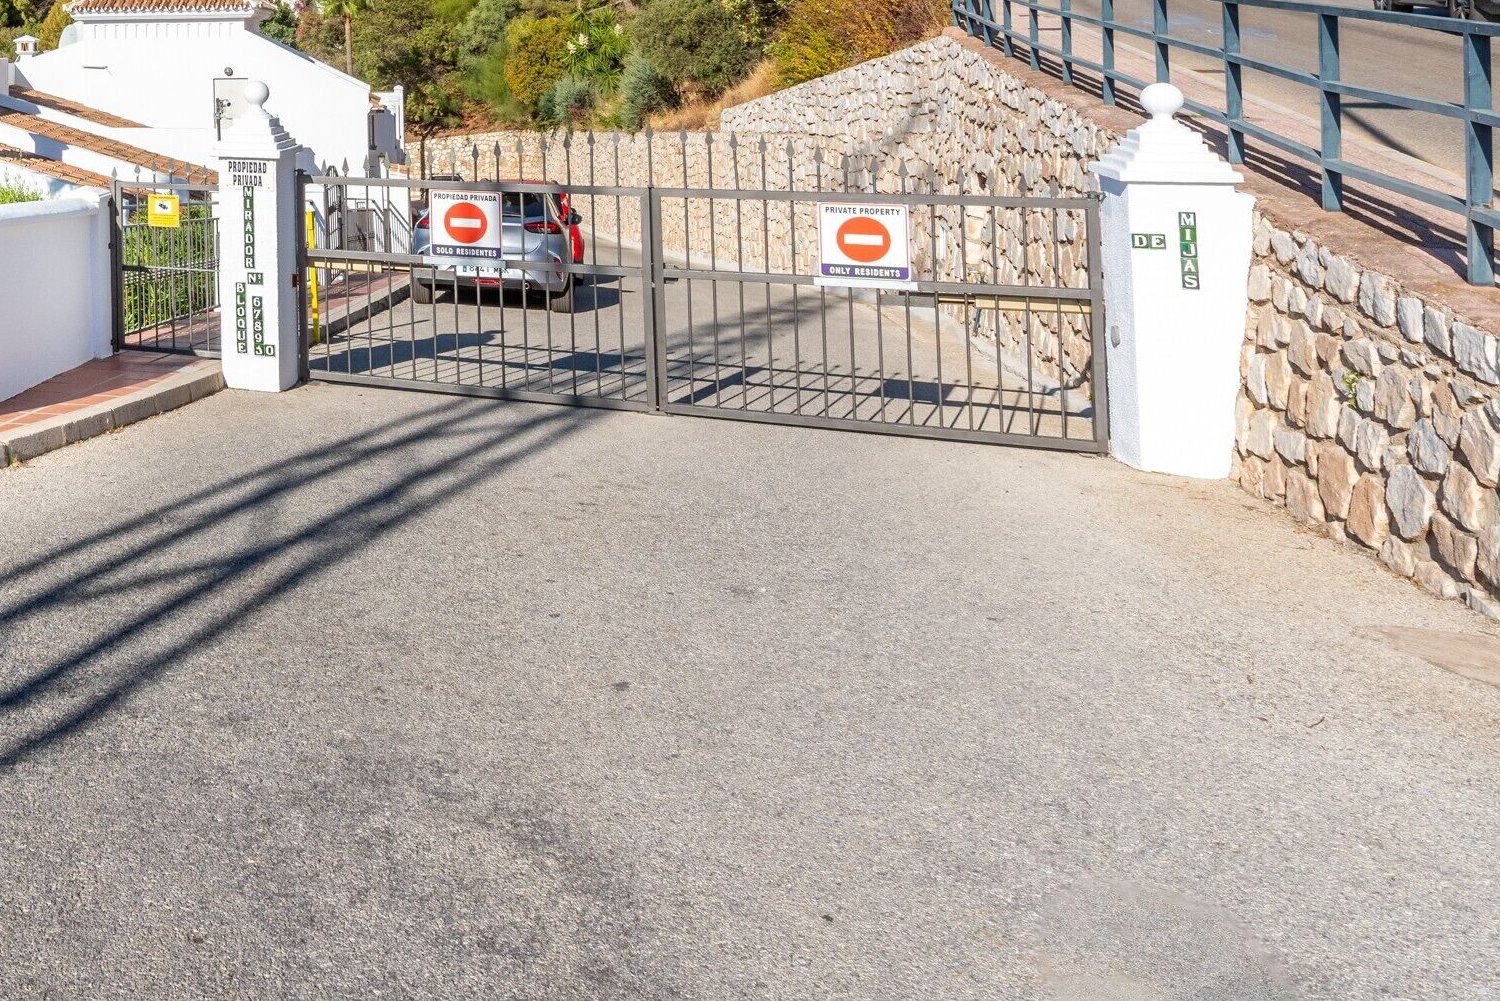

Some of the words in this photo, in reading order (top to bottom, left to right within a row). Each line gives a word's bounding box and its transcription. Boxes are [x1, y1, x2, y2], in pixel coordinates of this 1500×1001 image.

[228, 161, 267, 173] PROPIEDAD
[233, 175, 262, 187] PRIVADA
[433, 193, 468, 201] PROPIEDAD
[825, 206, 857, 214] PRIVATE
[859, 207, 900, 215] PROPERTY
[244, 187, 254, 268] MIRADOR
[1134, 235, 1165, 248] DE
[436, 247, 453, 255] SOLO
[456, 248, 497, 257] RESIDENTES
[1180, 213, 1198, 288] MIJAS
[829, 267, 851, 275] ONLY
[854, 268, 900, 277] RESIDENTS
[236, 283, 246, 352] BLOQUE
